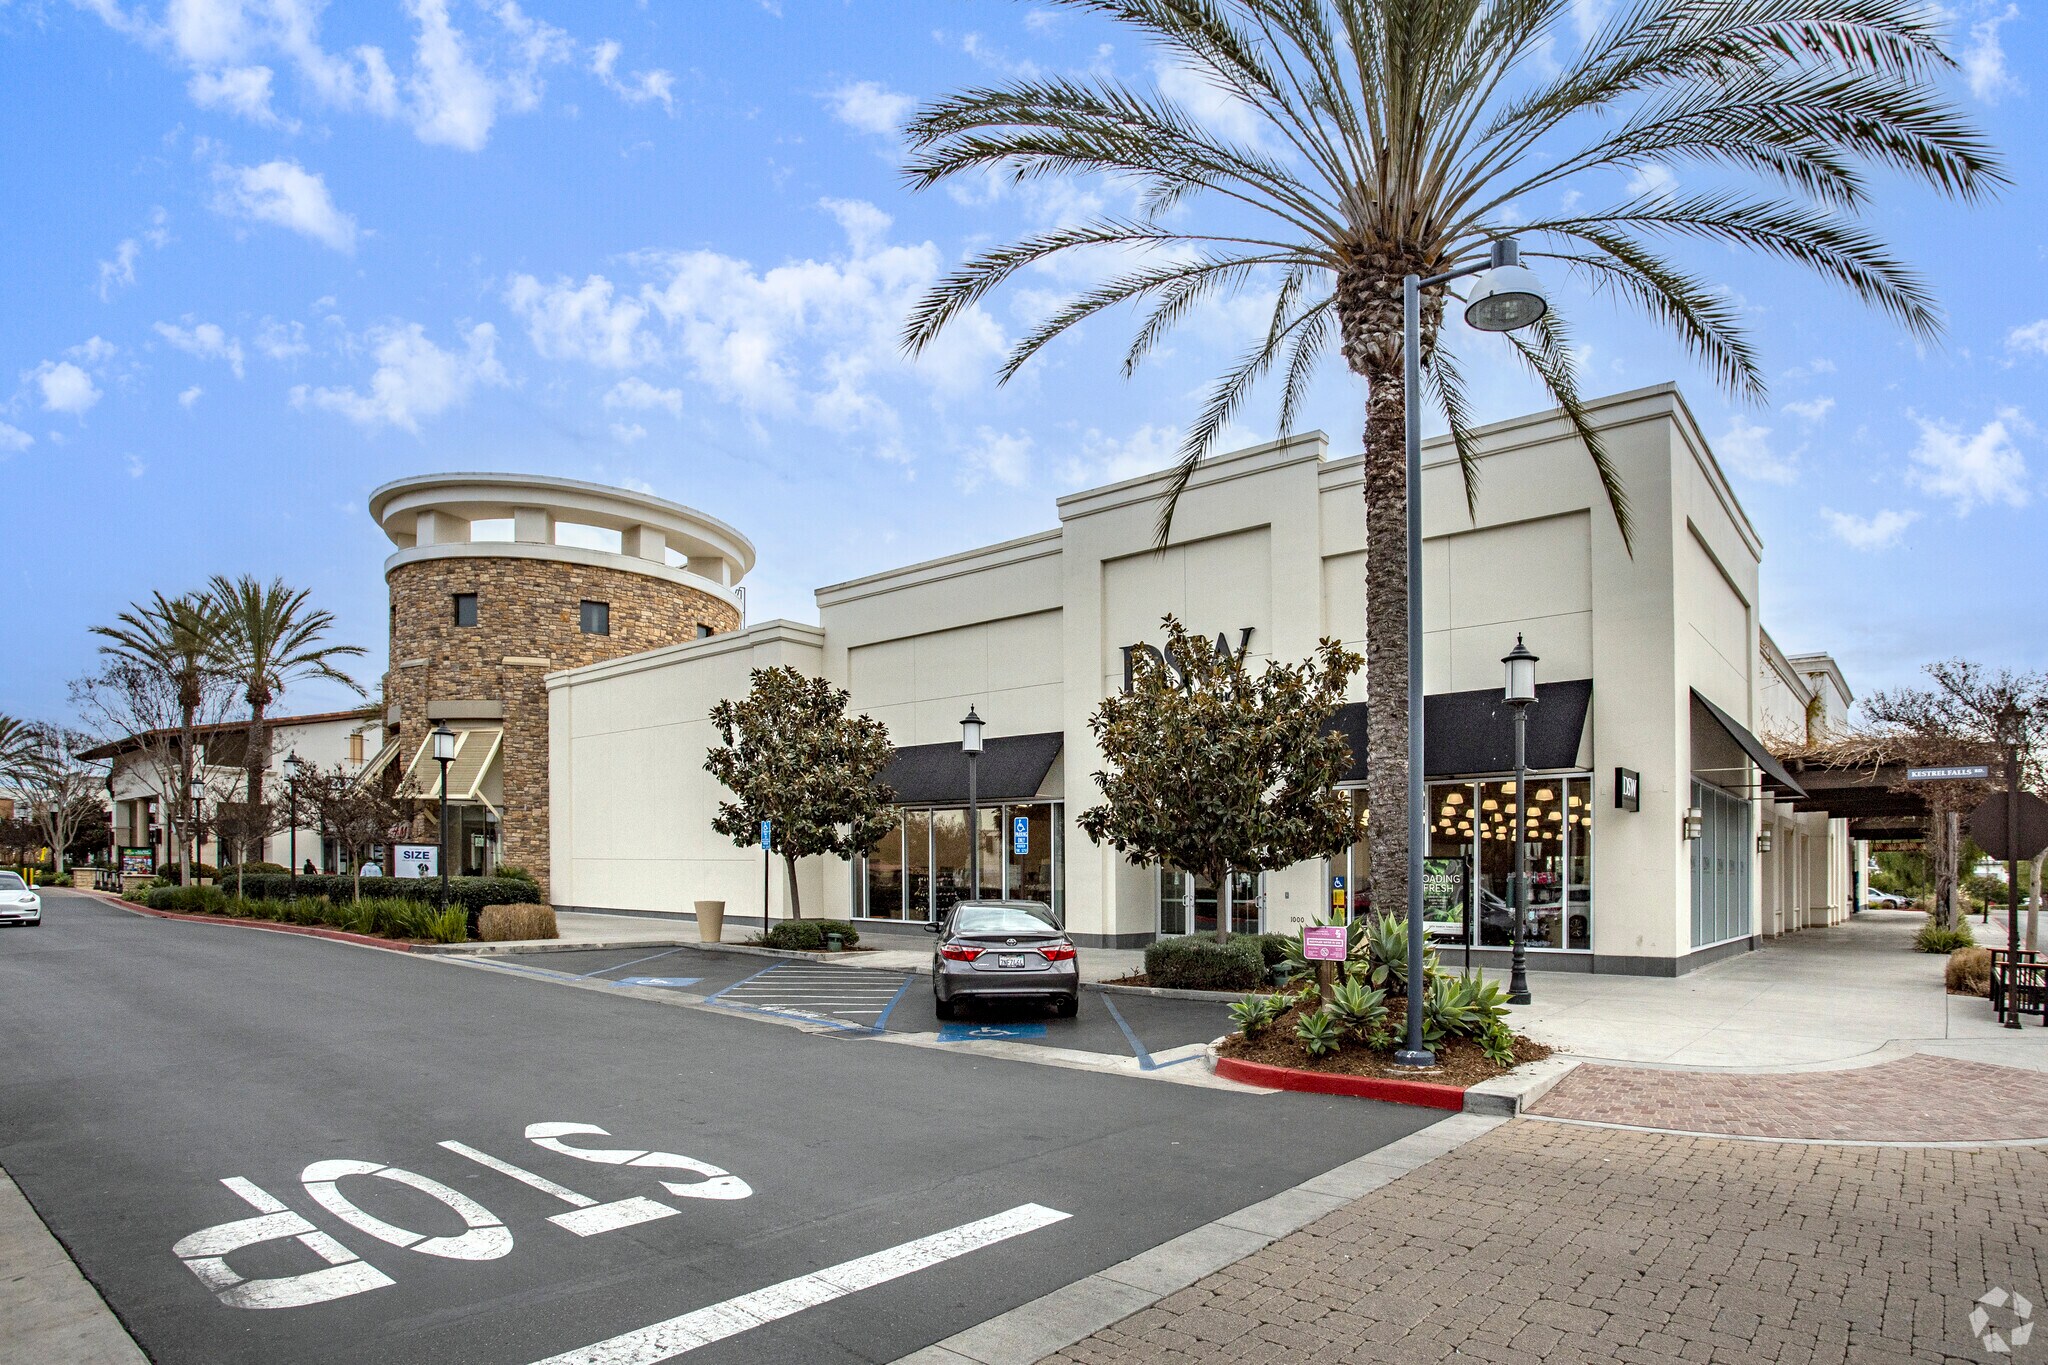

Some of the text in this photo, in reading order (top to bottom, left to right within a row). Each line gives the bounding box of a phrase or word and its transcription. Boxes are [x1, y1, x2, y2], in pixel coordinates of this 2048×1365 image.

[1911, 770, 1947, 778] KESTREL
[1622, 776, 1637, 797] DSW
[403, 850, 430, 860] SIZE
[1422, 874, 1461, 884] OADING
[1423, 884, 1454, 893] FRESH
[172, 1121, 754, 1310] STOP
